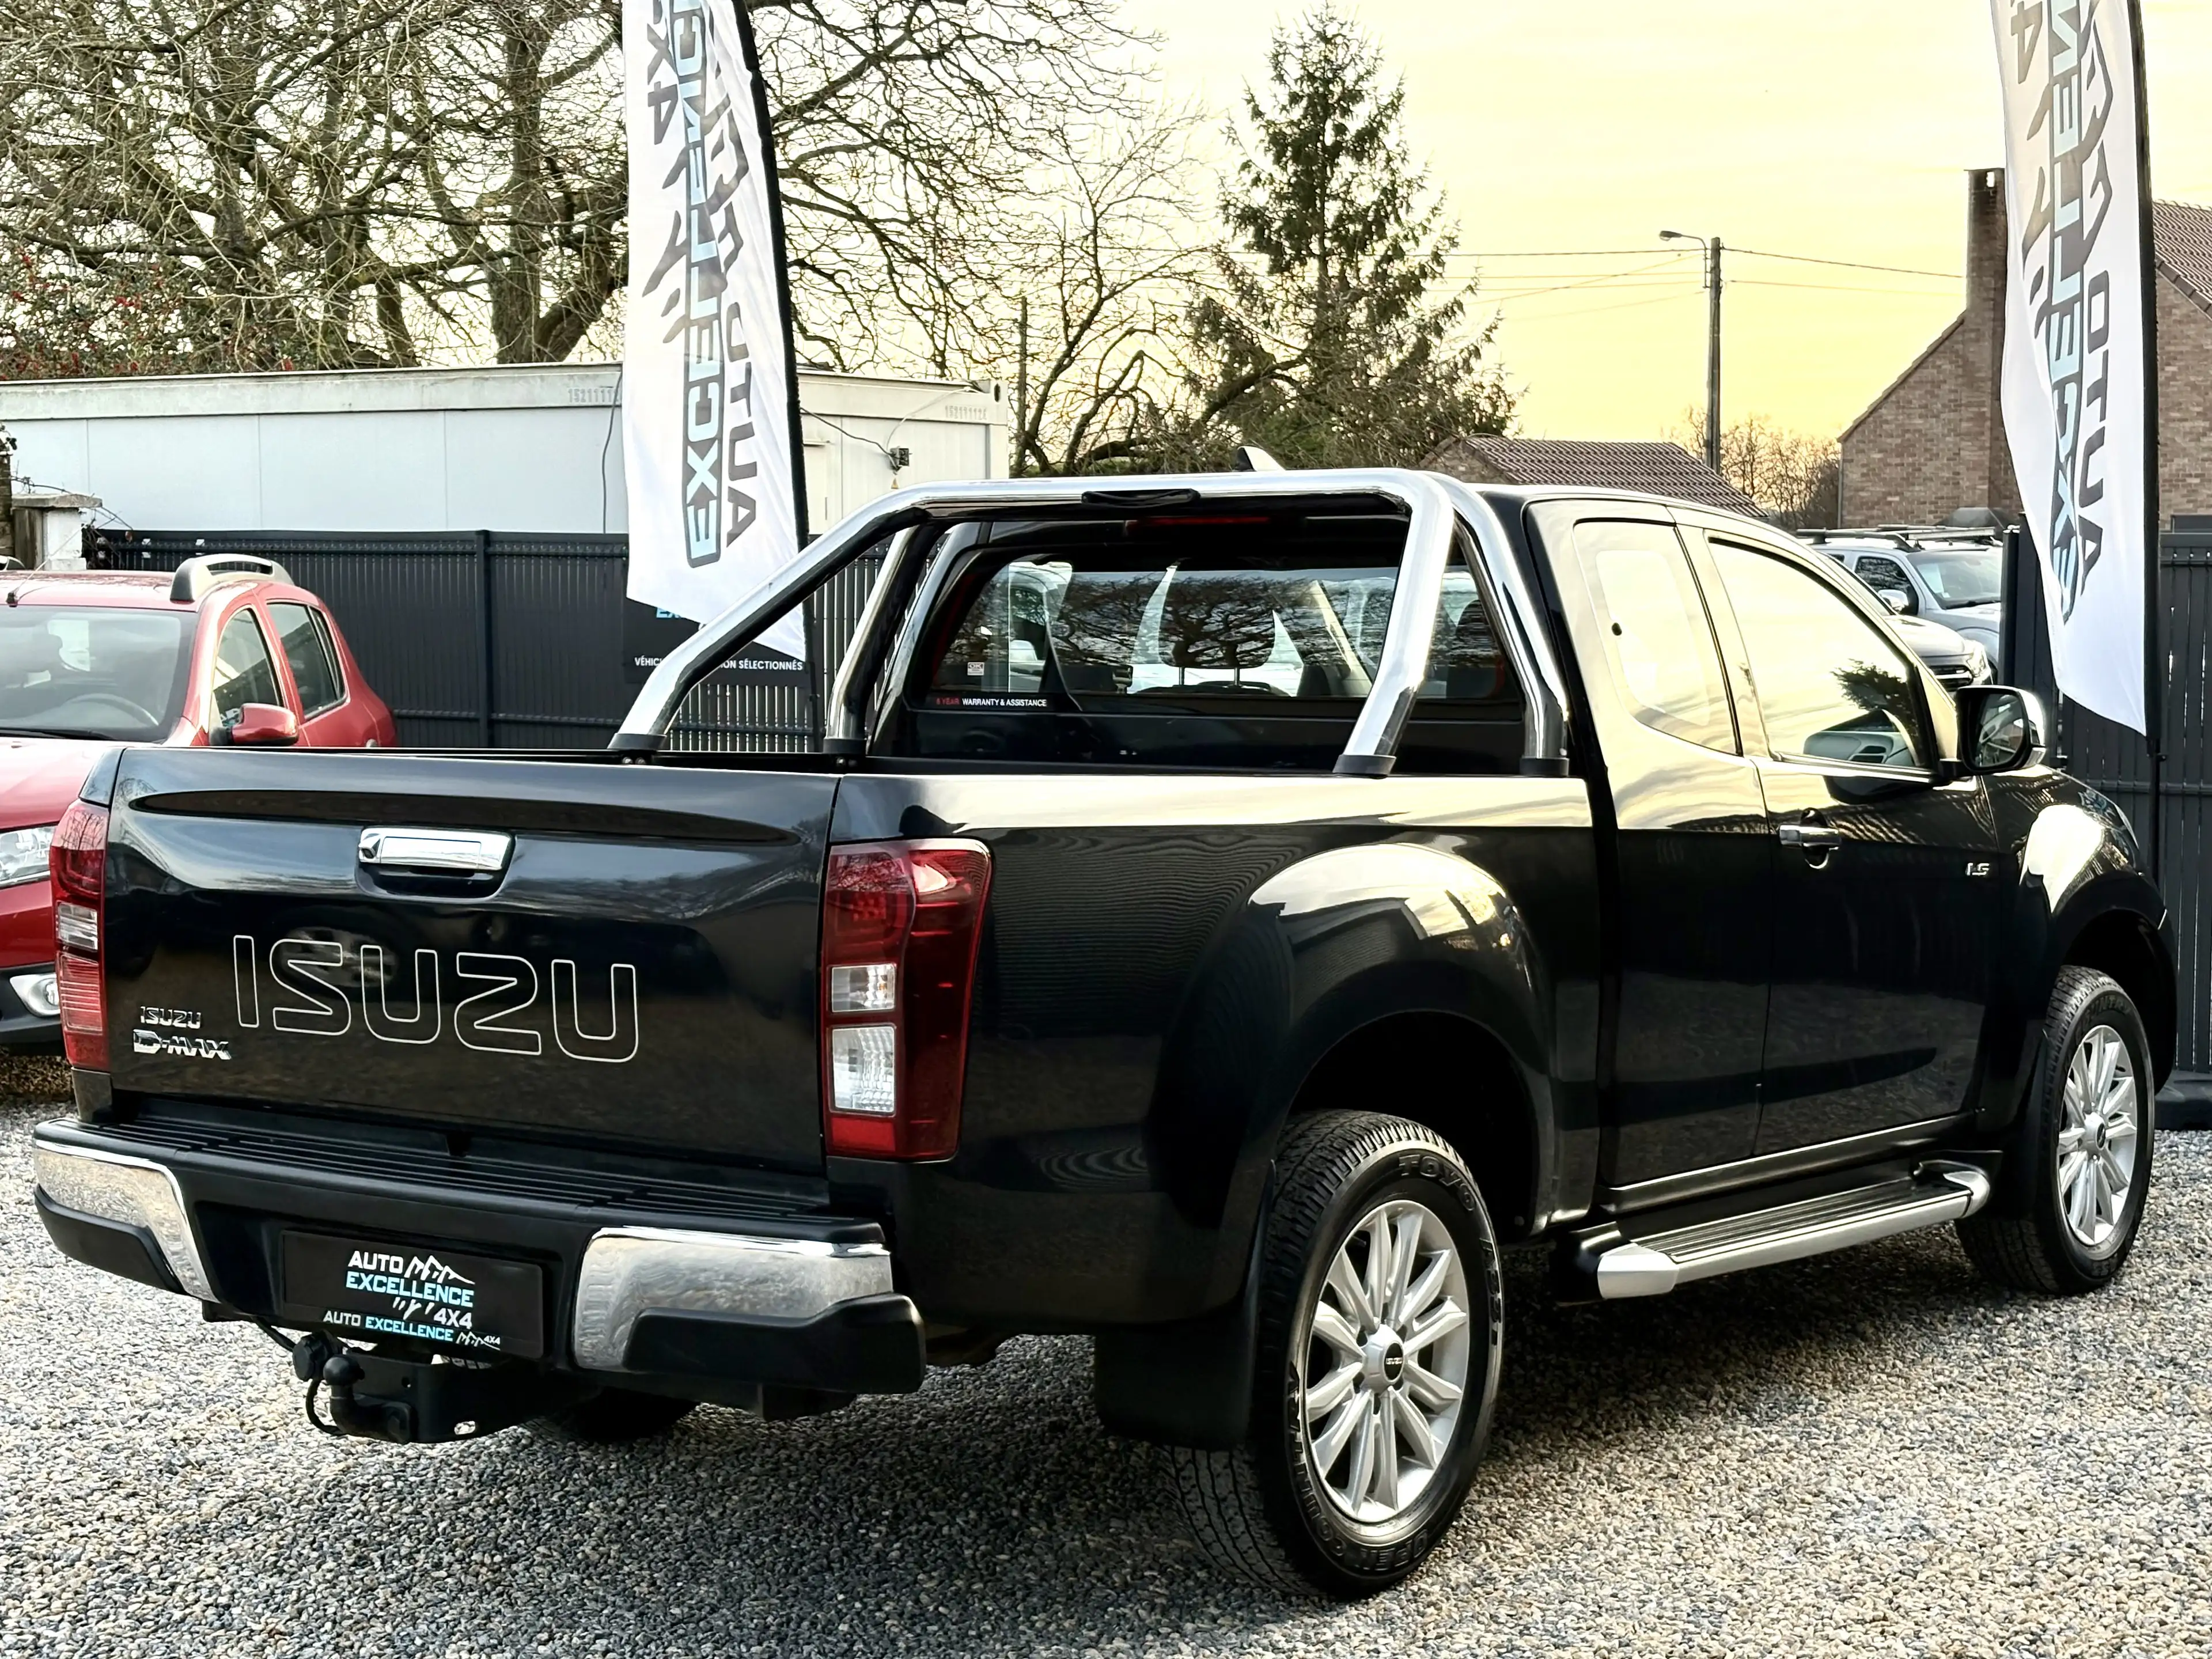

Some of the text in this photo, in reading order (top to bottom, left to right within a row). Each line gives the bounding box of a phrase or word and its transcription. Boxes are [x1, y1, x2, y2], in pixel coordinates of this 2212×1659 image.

[721, 660, 736, 669] ON
[738, 658, 803, 671] SÉLECTIONNÉS
[962, 698, 999, 706] WARRANTY
[1006, 698, 1047, 707] ASSISTANCE
[1965, 862, 1990, 876] LS
[233, 934, 639, 1063] ISUZU
[141, 1006, 202, 1029] ISUZU
[133, 1029, 232, 1060] D-MAX
[1398, 1154, 1477, 1211] TOYO
[348, 1251, 404, 1274] AUTO
[346, 1271, 475, 1308] EXCELLENCE
[323, 1310, 501, 1344] AUTO EXCELLENCE 4X4
[434, 1308, 472, 1330] 4X4
